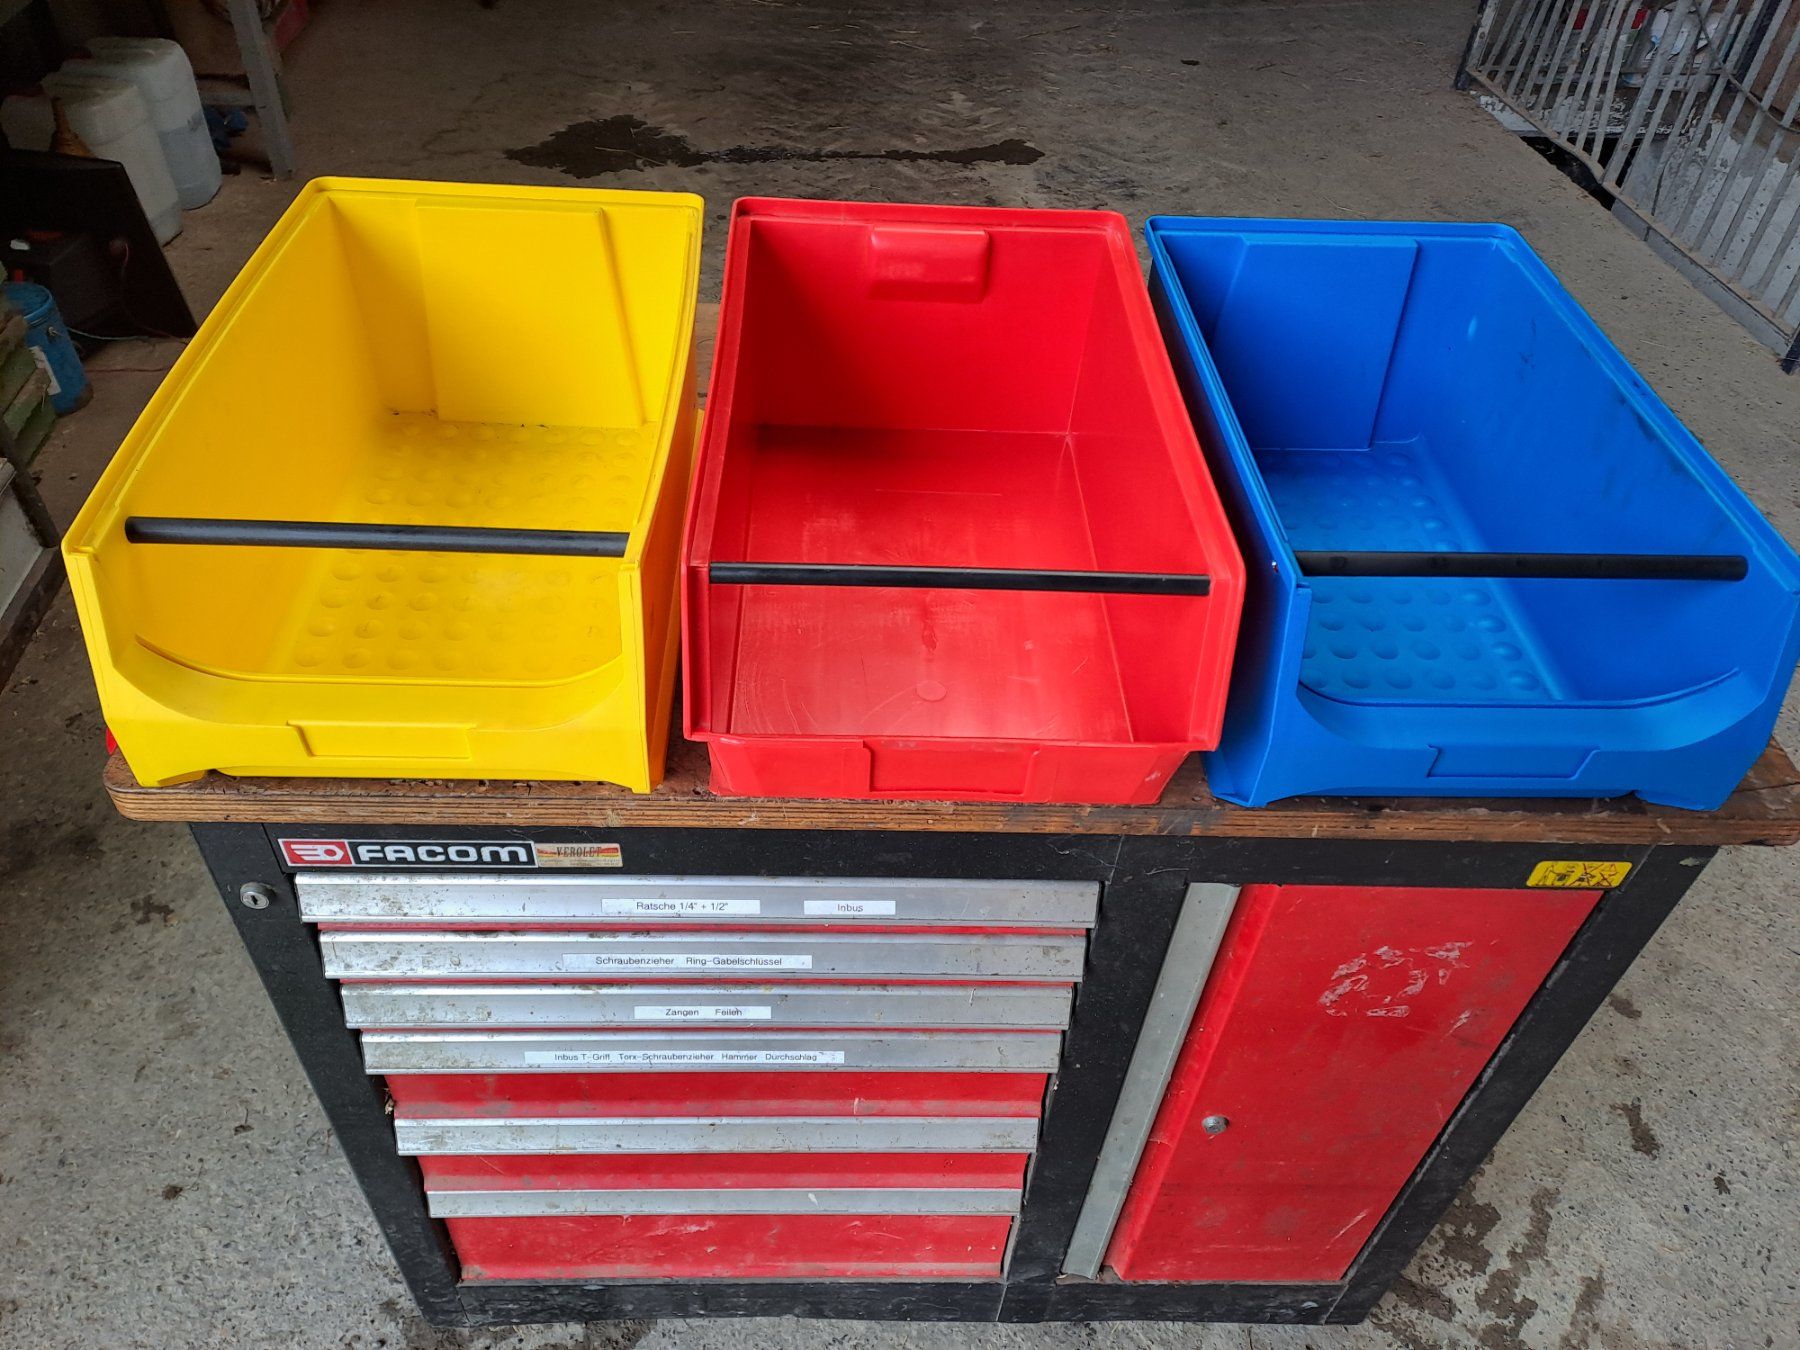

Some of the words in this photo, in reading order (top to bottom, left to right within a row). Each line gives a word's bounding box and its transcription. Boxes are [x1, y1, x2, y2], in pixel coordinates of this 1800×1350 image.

[357, 845, 528, 862] FACOM
[636, 901, 676, 911] Ratsche
[837, 903, 864, 913] Inbus
[595, 956, 675, 965] Schraubenzieher
[665, 1008, 699, 1017] Zangen
[715, 1008, 743, 1016] Feilen
[721, 1053, 758, 1061] Hammer
[765, 1053, 818, 1062] Durchschlag
